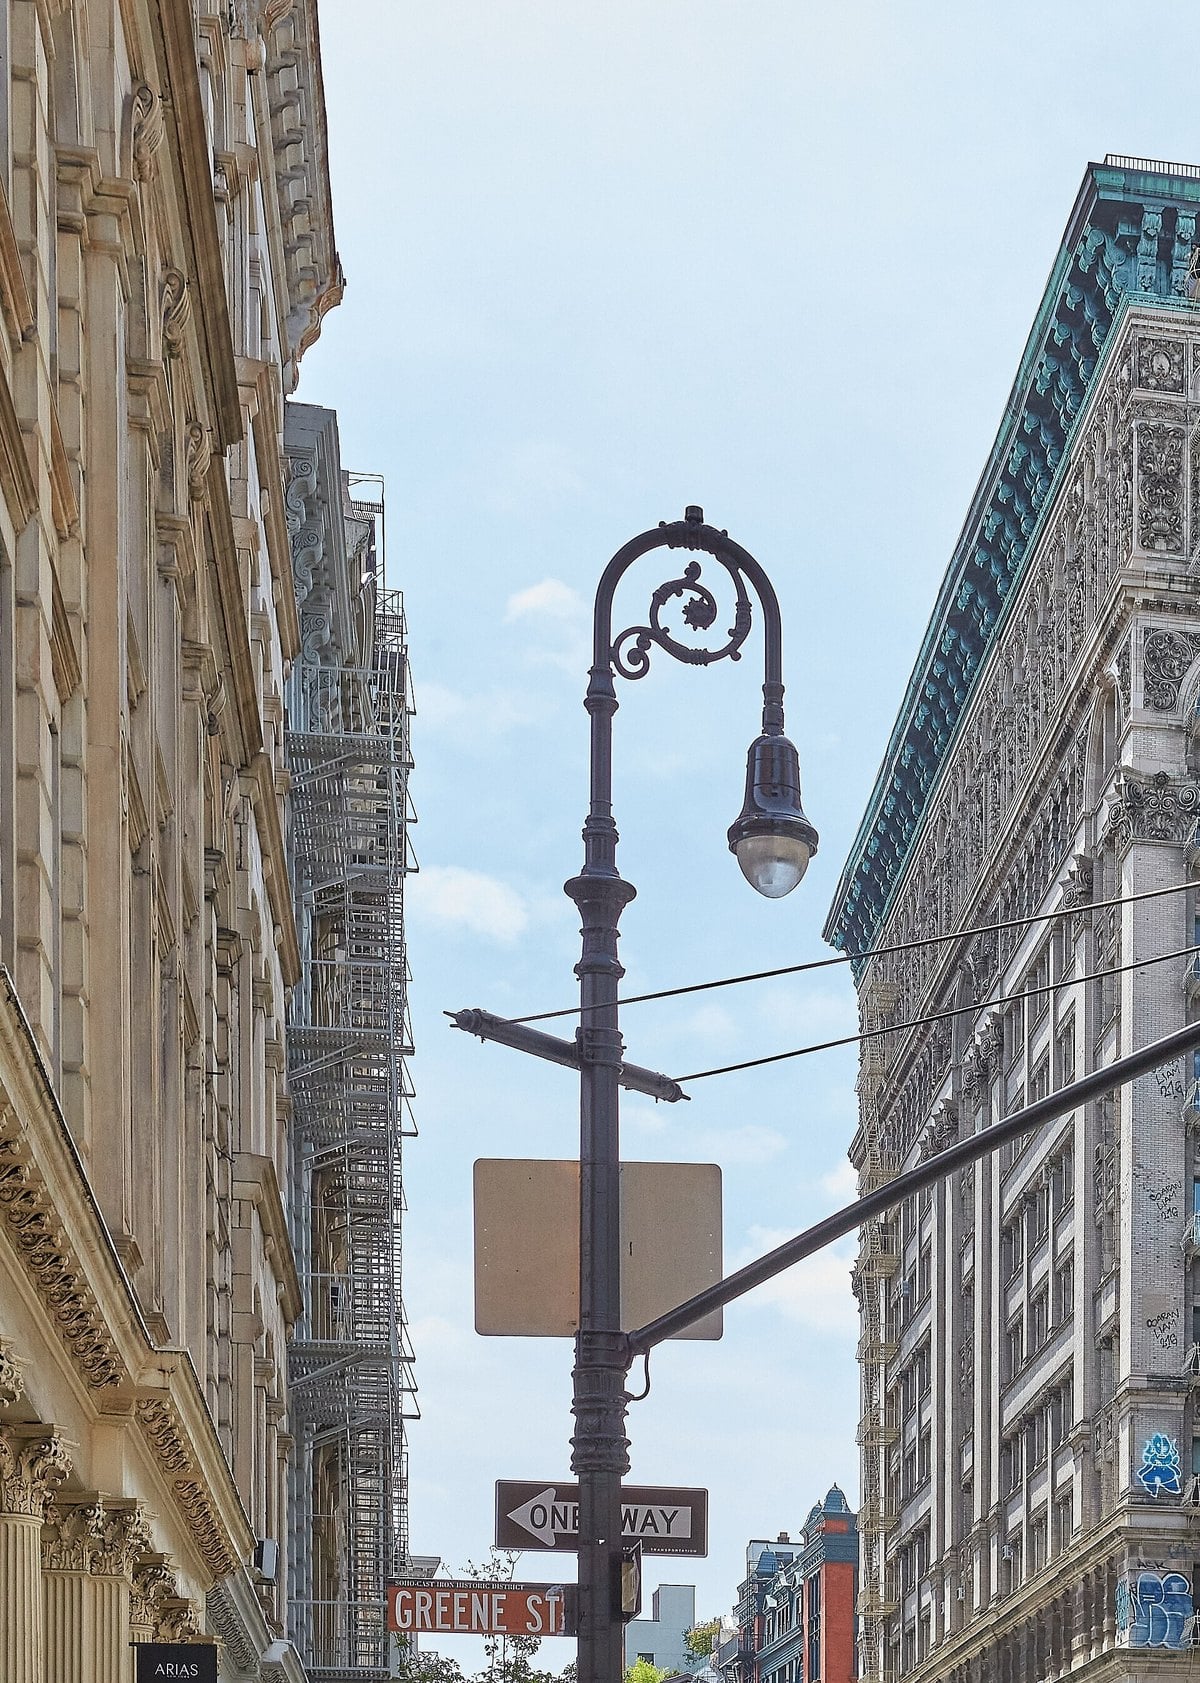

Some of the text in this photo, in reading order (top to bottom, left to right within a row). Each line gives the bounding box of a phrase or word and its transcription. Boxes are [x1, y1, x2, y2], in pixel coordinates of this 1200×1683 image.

[622, 1508, 679, 1535] WAY
[395, 1580, 434, 1588] SOHO-CAST
[491, 1583, 525, 1591] DISTRICT
[395, 1590, 560, 1633] GREENE ST
[154, 1663, 199, 1676] ARIAS
